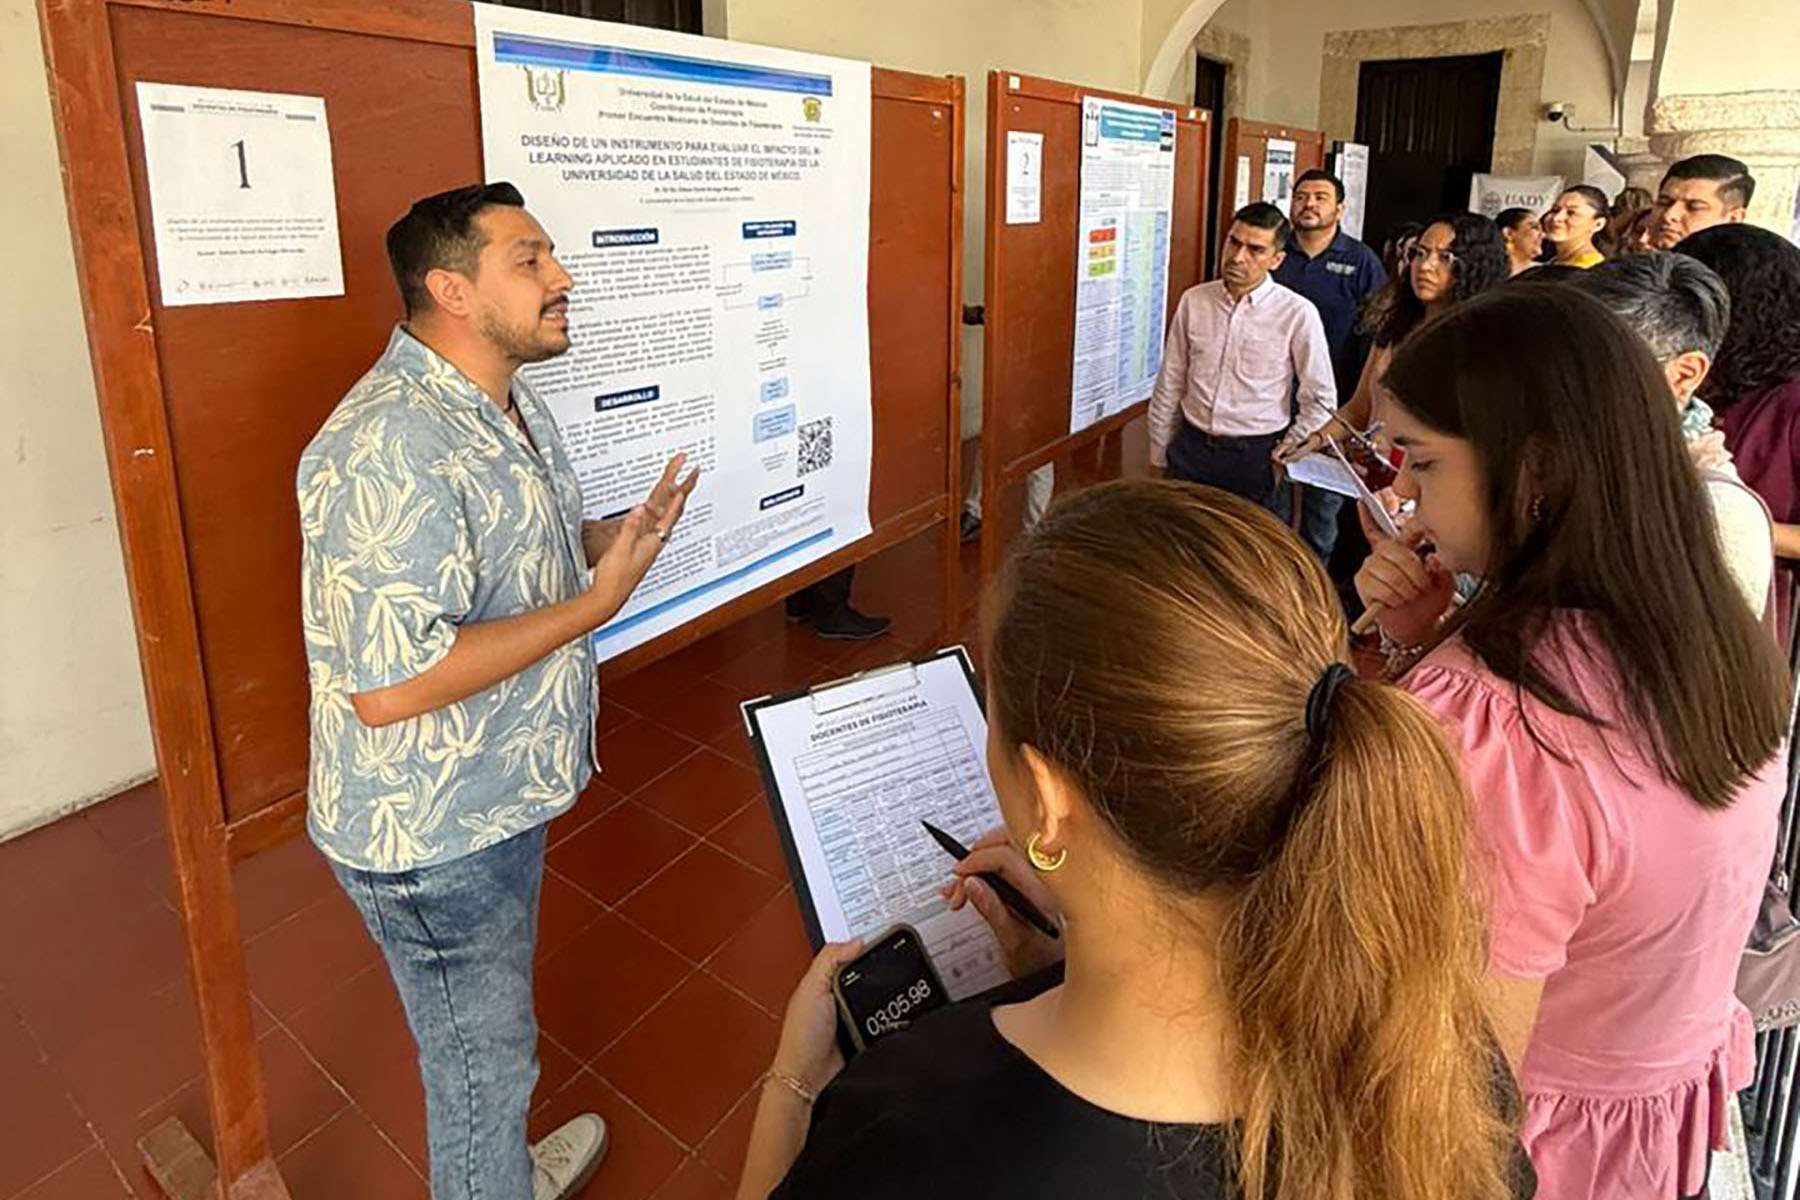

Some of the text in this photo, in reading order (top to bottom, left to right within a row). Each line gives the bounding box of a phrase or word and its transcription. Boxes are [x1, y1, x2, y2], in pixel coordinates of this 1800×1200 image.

[521, 131, 570, 148] DISEÑO
[572, 135, 588, 149] DE
[591, 138, 608, 150] UN
[610, 138, 683, 151] INSTRUMENTO
[685, 141, 710, 152] PARA
[710, 142, 749, 153] EVALUAR
[231, 139, 252, 189] 1
[529, 151, 593, 164] LEARNING
[595, 154, 650, 166] APLICADO
[652, 155, 667, 166] EN
[668, 155, 729, 167] ESTUDIANTES
[562, 169, 639, 181] UNIVERSIDAD
[641, 170, 656, 181] DE
[658, 170, 671, 181] LA
[672, 170, 703, 181] SALUD
[705, 170, 721, 181] DEL
[724, 170, 758, 181] ESTADO
[595, 231, 657, 245] INTRODUCCIÓN
[810, 719, 858, 742] DOCENTES
[858, 717, 871, 727] DE
[871, 700, 928, 722] FISIOTERAPIA
[866, 978, 931, 1036] 03:05.98
